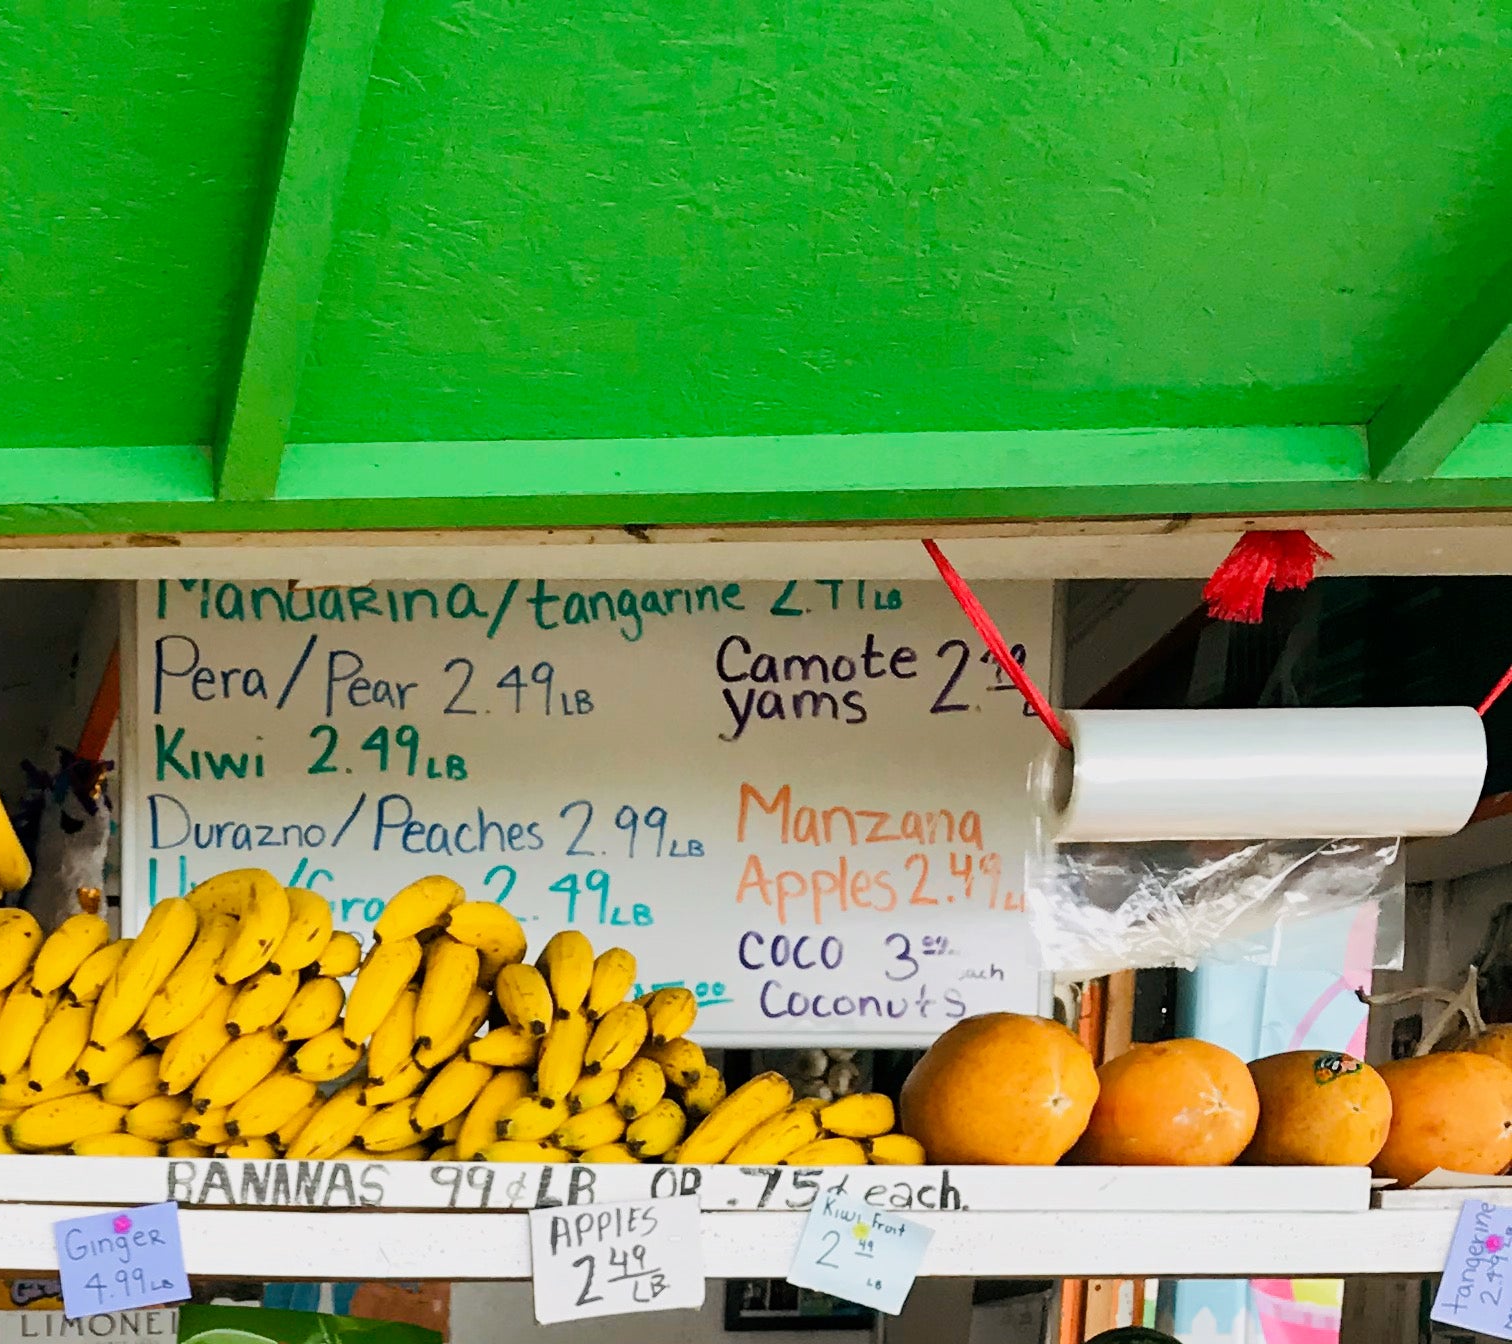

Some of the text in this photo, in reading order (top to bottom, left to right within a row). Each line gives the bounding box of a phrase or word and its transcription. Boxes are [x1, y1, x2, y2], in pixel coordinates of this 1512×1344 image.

[152, 634, 419, 718] Pera/Pear
[716, 634, 918, 684] Camote
[718, 688, 868, 742] yams
[307, 725, 420, 777] 2.49
[148, 793, 544, 854] Durazno/Peaches
[736, 783, 982, 848] Manzana
[735, 855, 897, 925] Apples
[166, 1160, 389, 1206] BANANAS
[815, 1230, 841, 1269] 2
[573, 1254, 605, 1306] 2
[632, 1280, 670, 1303] LB
